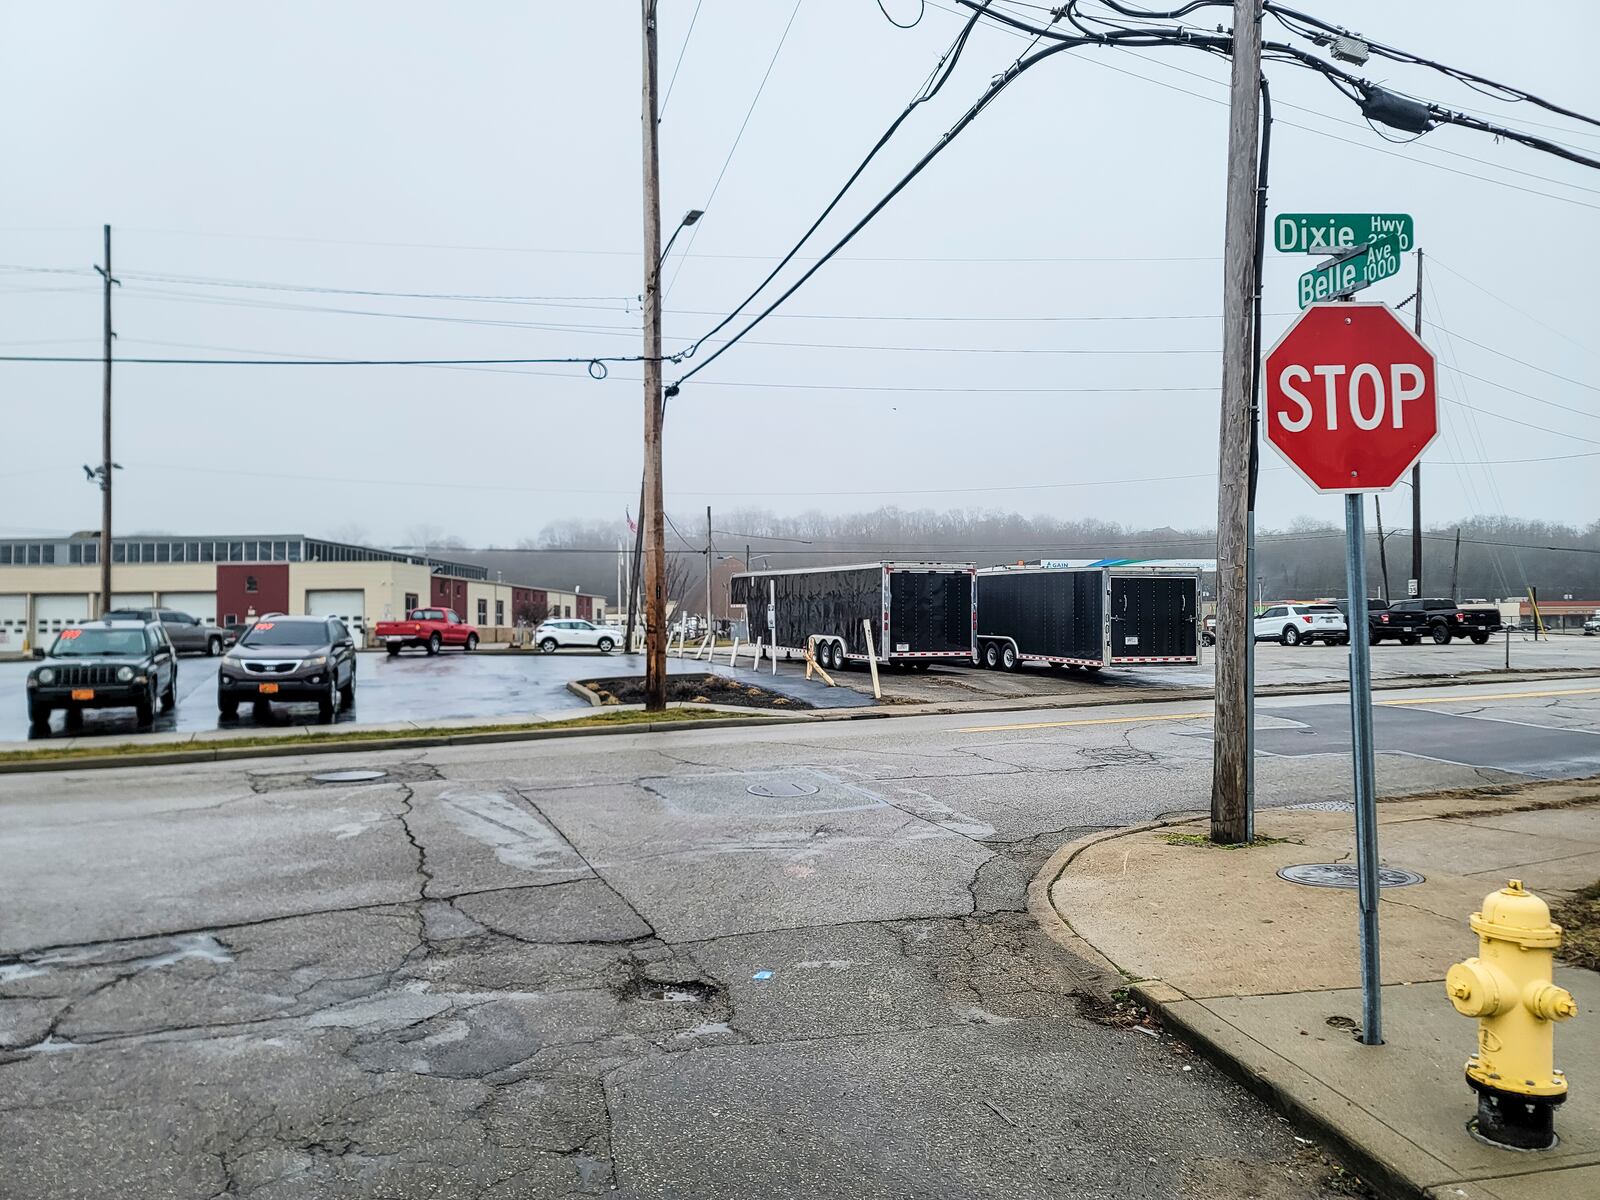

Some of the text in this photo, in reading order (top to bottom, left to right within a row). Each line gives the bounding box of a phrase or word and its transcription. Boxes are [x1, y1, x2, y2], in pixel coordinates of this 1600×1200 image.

[1279, 216, 1405, 250] Dixie Hwy
[1368, 233, 1408, 249] 20
[1301, 244, 1391, 307] Belle Ave
[1363, 256, 1397, 281] 1000
[1277, 363, 1426, 433] STOP
